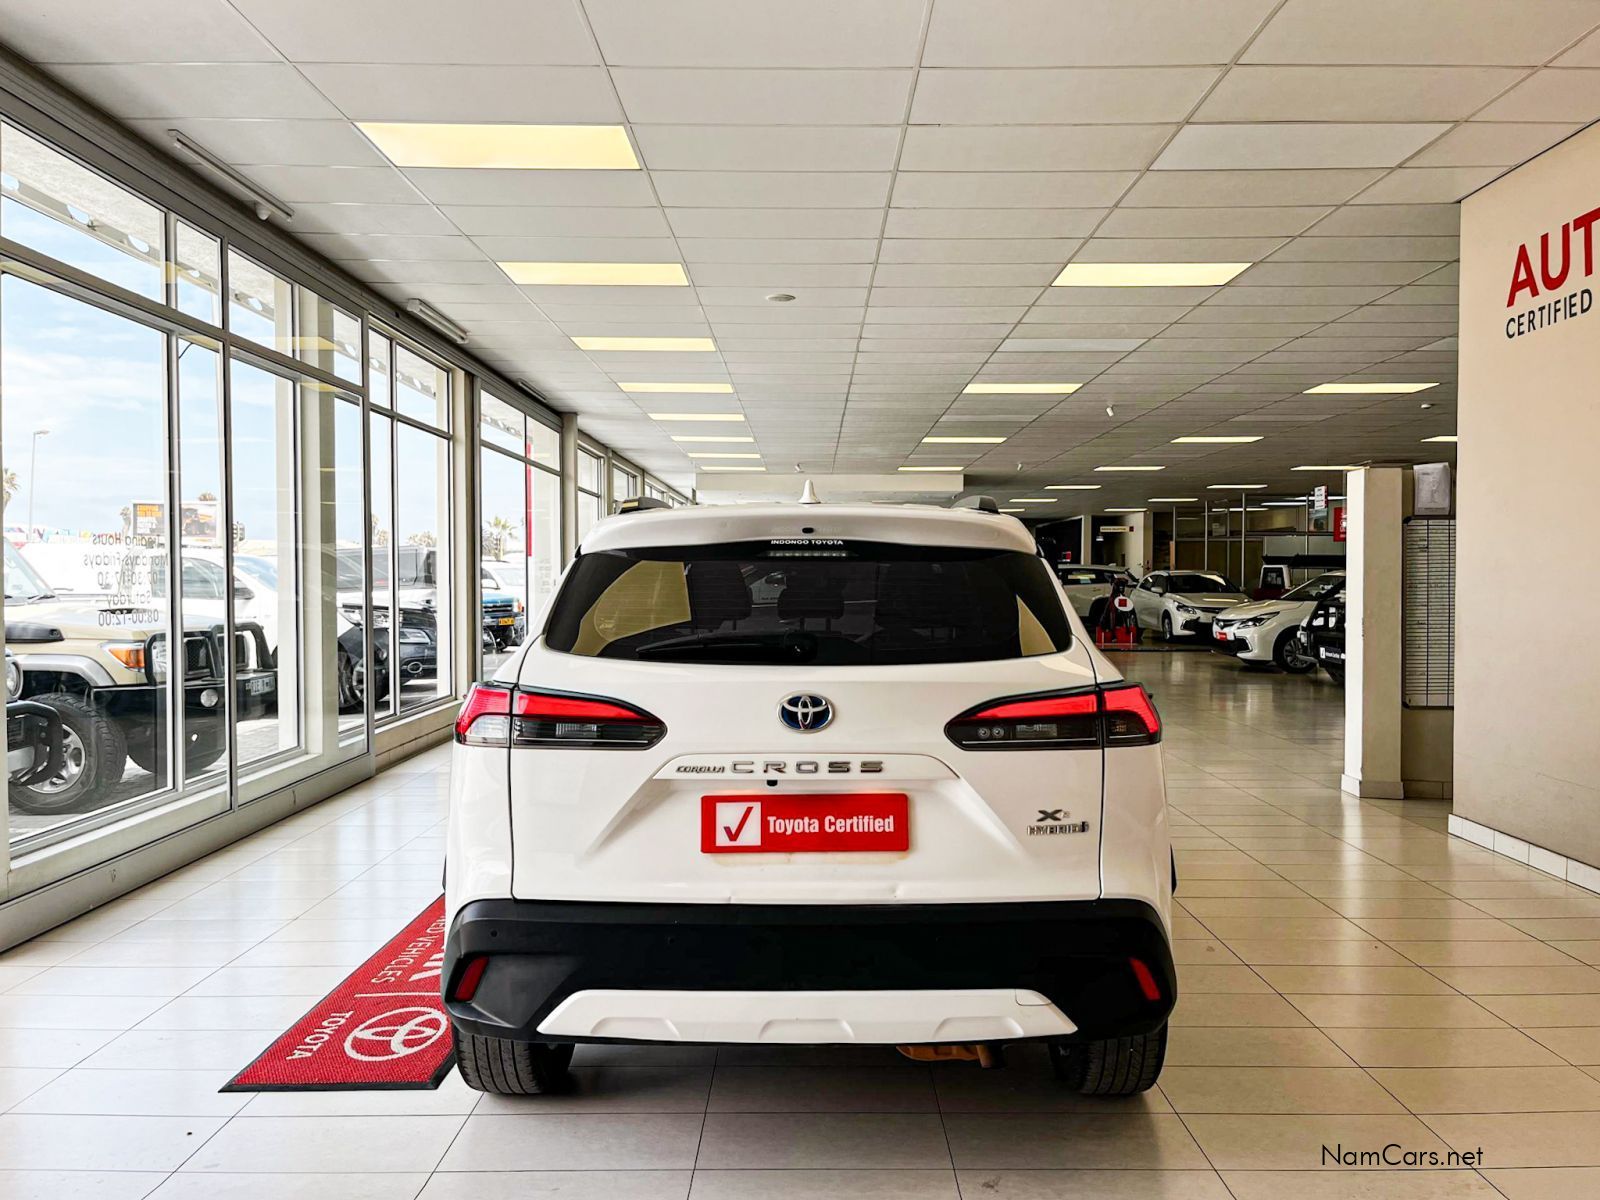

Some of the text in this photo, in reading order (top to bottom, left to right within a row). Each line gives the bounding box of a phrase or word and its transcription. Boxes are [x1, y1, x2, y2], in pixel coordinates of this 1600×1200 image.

[1506, 288, 1593, 339] CERTIFIED
[675, 761, 883, 773] COROLLA CROSS
[767, 815, 894, 836] Toyota Certified
[370, 935, 440, 983] VEHICLES
[286, 1010, 356, 1061] TOYOTA
